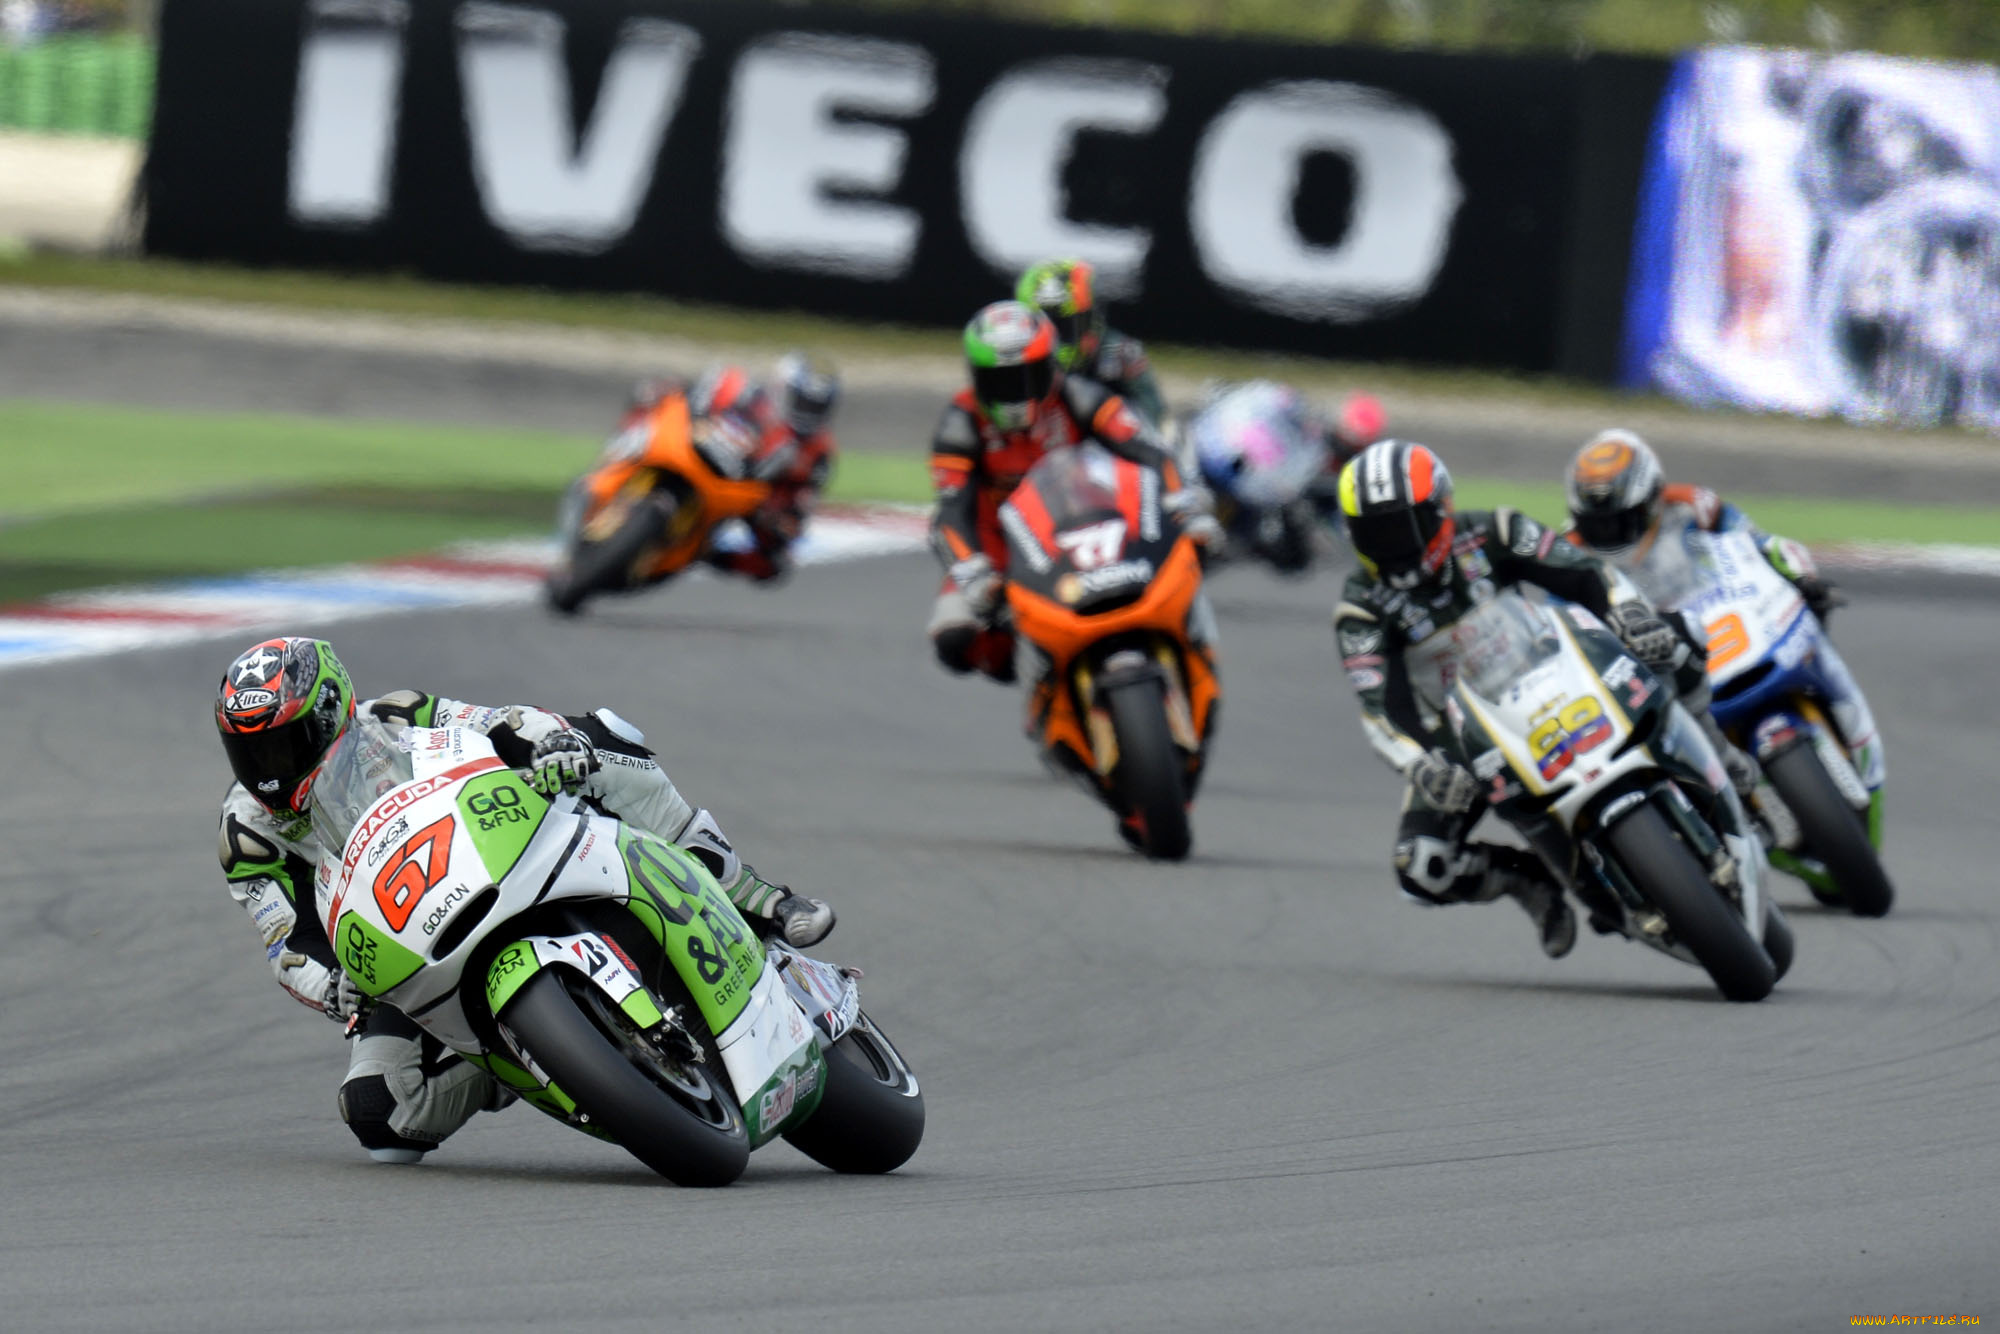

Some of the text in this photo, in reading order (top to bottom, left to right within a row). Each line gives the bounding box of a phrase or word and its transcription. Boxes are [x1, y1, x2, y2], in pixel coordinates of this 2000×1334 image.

[287, 0, 1464, 323] IVECO
[1056, 516, 1128, 571] 77
[229, 689, 269, 710] X-lite
[467, 784, 520, 815] GO
[479, 806, 530, 831] &FUN
[336, 775, 454, 897] BARRACUDA
[578, 833, 596, 862] HONDA
[372, 812, 456, 934] 67
[422, 883, 470, 936] GO&FUN
[346, 922, 364, 974] GO
